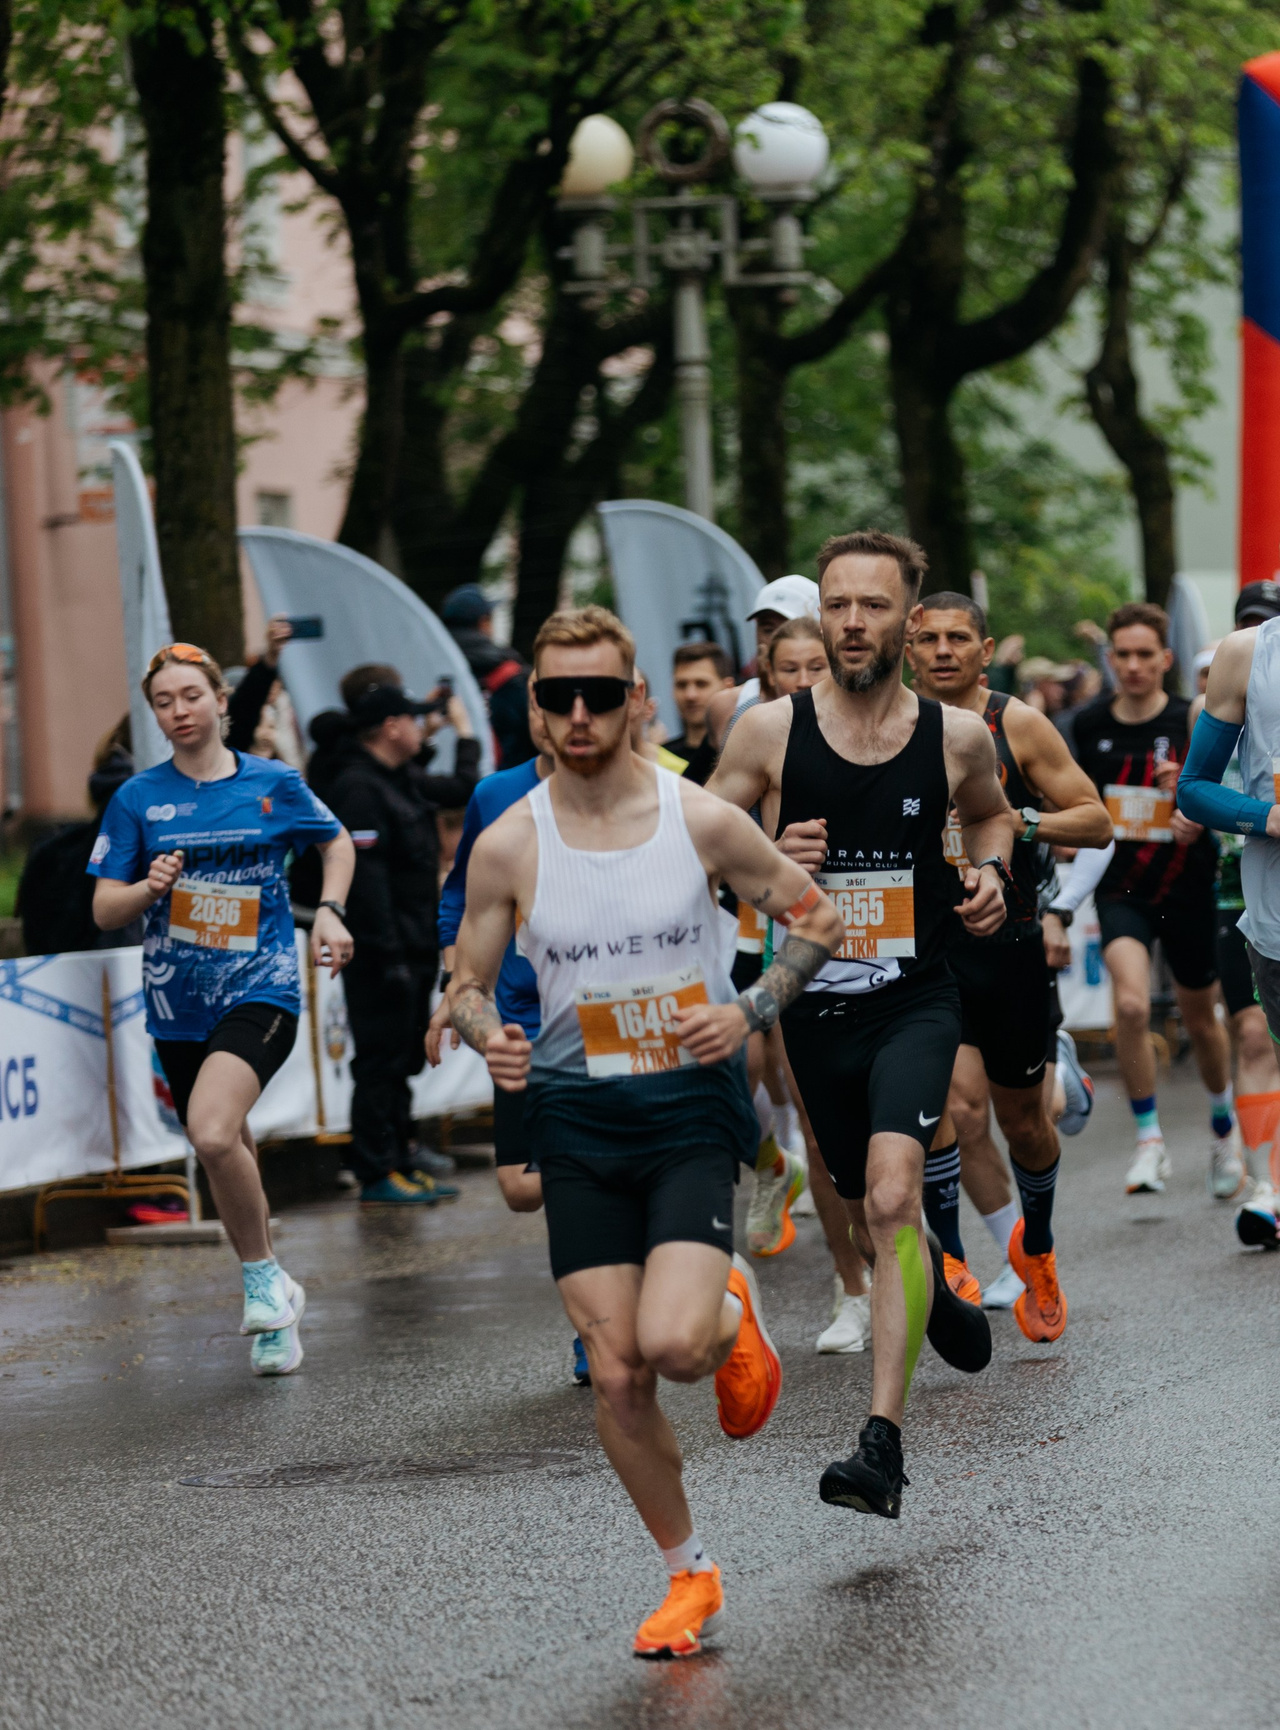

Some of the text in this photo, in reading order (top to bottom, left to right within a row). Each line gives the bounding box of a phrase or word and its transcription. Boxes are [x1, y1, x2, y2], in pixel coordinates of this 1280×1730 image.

[189, 895, 242, 927] 2036
[827, 890, 885, 927] 655
[607, 935, 644, 956] WE
[0, 1056, 39, 1121] СБ
